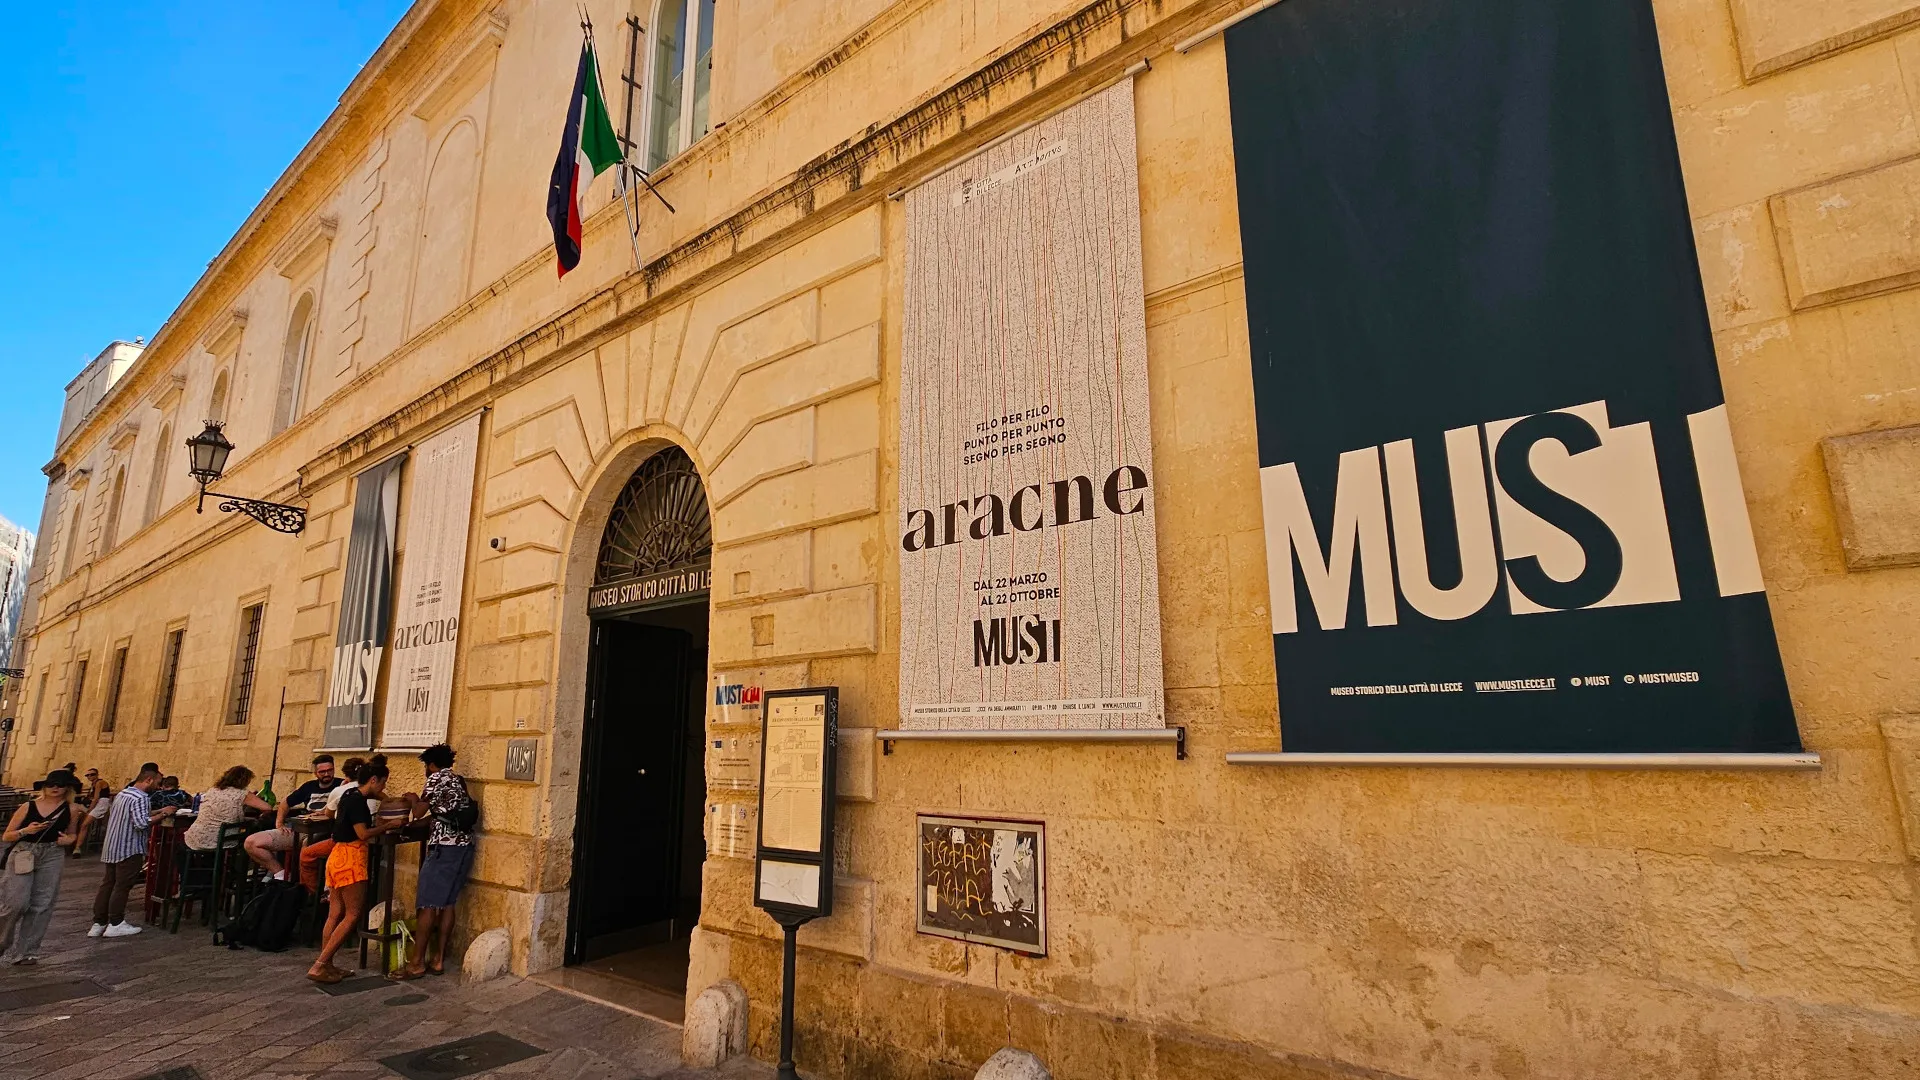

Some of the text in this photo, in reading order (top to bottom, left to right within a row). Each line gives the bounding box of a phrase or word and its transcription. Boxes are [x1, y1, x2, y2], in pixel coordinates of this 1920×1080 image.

[964, 417, 1065, 450] PUNTO PER PUNTO
[976, 404, 1050, 433] FILO PER FILO
[963, 432, 1067, 465] SEGNO PER SEGNO
[902, 465, 1149, 552] aracne
[1260, 400, 1765, 634] MUST
[590, 568, 712, 608] MUSEO STORICO CITTÀ DI LE
[973, 572, 1048, 591] DAL 22 MARZO
[980, 587, 1060, 606] AL 22 OTTOBRE
[394, 616, 458, 650] aracne
[973, 613, 1060, 668] MUST
[327, 640, 384, 708] MUST
[1330, 671, 1700, 696] MUSEO STORICO DELLA CITTÀ DI LECCE WWW.MUSTLECCE.IT MUST MUSTMUSEO
